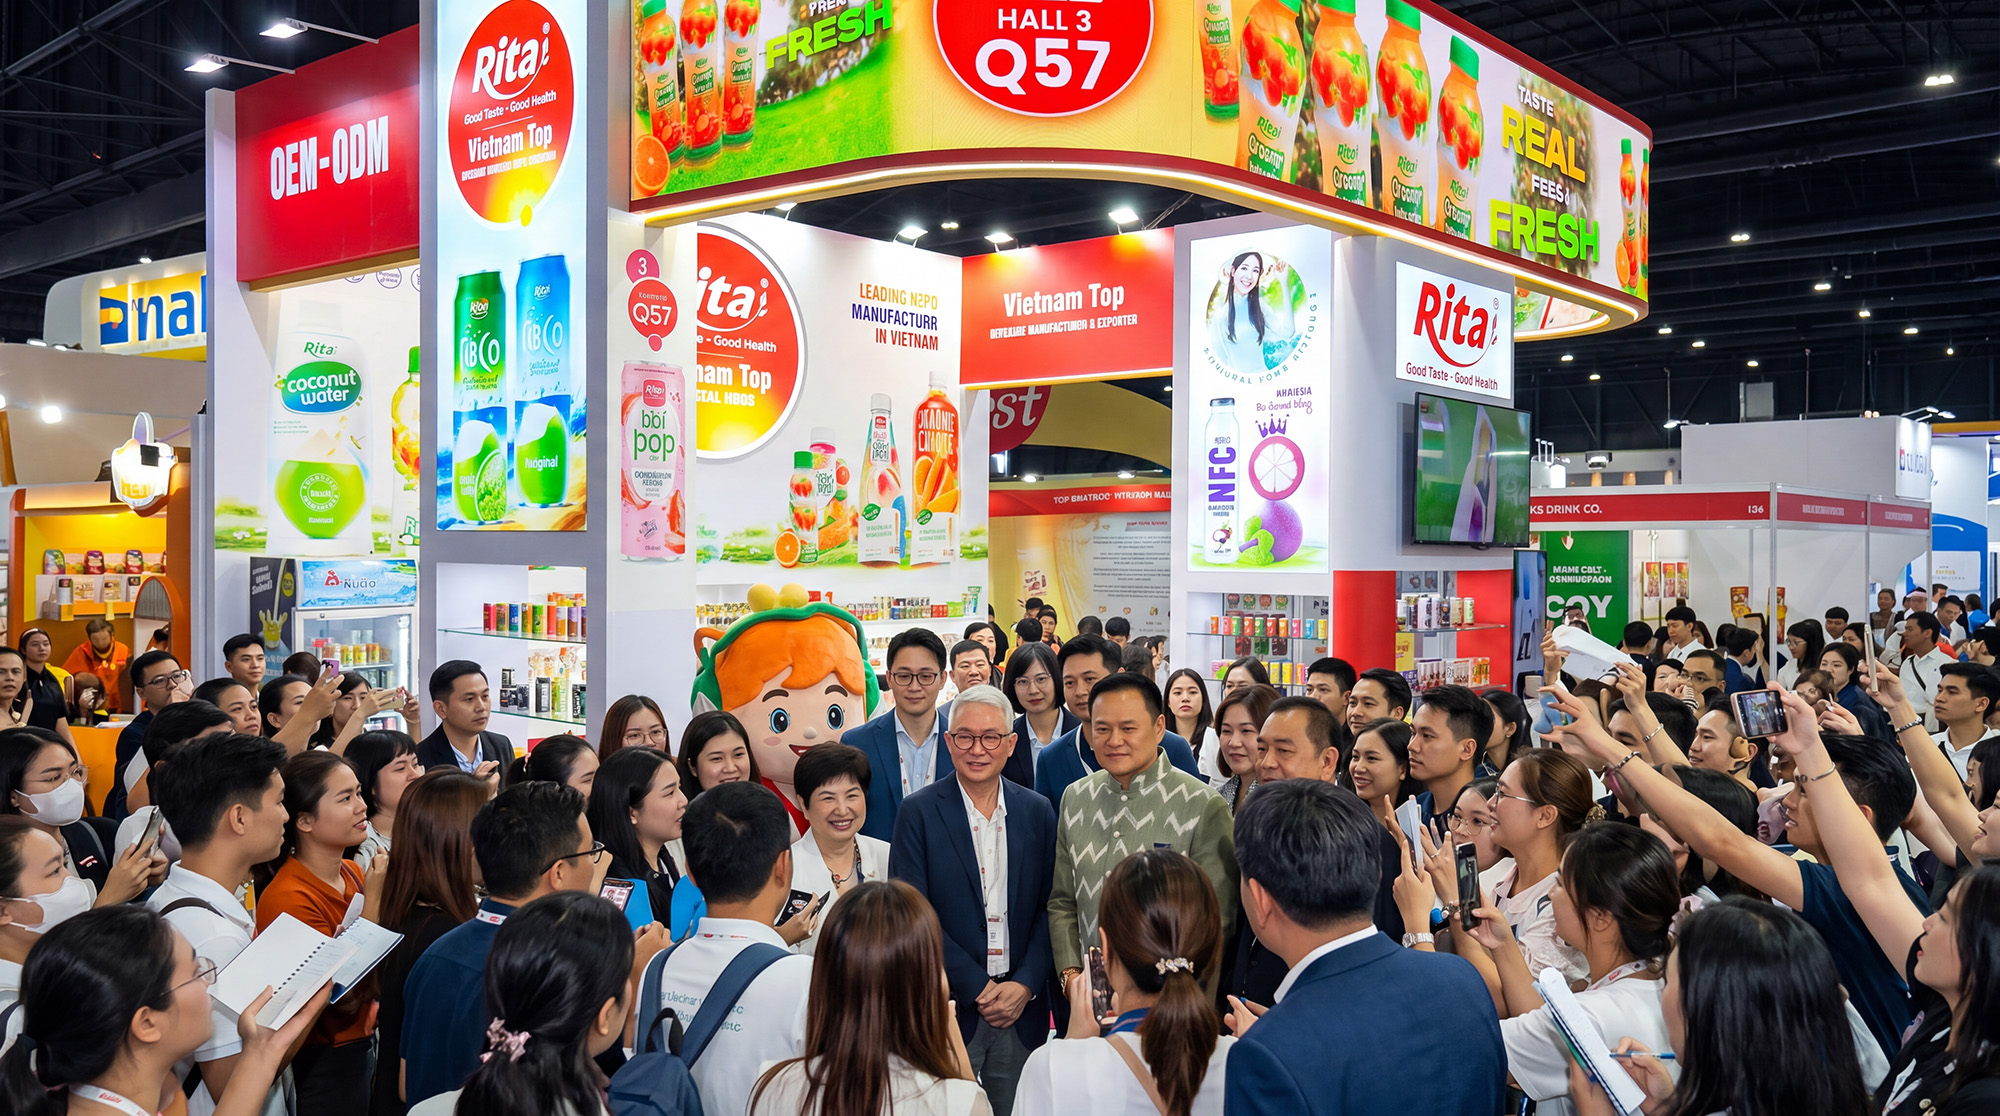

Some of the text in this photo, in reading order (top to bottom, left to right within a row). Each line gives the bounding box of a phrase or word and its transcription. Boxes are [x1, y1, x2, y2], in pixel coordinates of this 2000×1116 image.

[998, 8, 1091, 31] HALL 3
[766, 0, 893, 69] FRESH
[975, 38, 1110, 95] Q57
[464, 108, 483, 125] Good
[510, 97, 530, 113] Good
[532, 90, 557, 107] Health
[1518, 84, 1554, 118] TASTE
[468, 122, 553, 163] Vietnam Top
[1502, 103, 1586, 183] REAL
[270, 115, 389, 201] OEM-ODM
[1531, 174, 1565, 204] FEES
[1489, 198, 1599, 262] FRESH
[637, 256, 648, 276] 3
[859, 282, 907, 306] LEADING
[1003, 283, 1125, 317] Vietnam Top
[632, 302, 673, 326] Q57
[851, 303, 938, 332] MANUFACTURR
[1097, 313, 1138, 329] EXPORTER
[713, 334, 742, 349] Good
[743, 338, 777, 353] Health
[875, 327, 939, 351] IN VIETNAM
[287, 370, 357, 393] coconut
[739, 363, 772, 395] Top
[1406, 362, 1427, 377] Good
[1428, 366, 1449, 381] Taste
[1454, 372, 1473, 386] Good
[1475, 377, 1498, 391] Health
[300, 388, 350, 406] water
[633, 428, 676, 462] pop
[1208, 446, 1236, 502] NFC
[1053, 496, 1070, 504] TOP
[1546, 504, 1581, 515] DRINK
[1583, 503, 1603, 514] CO.
[1546, 594, 1613, 619] COY
